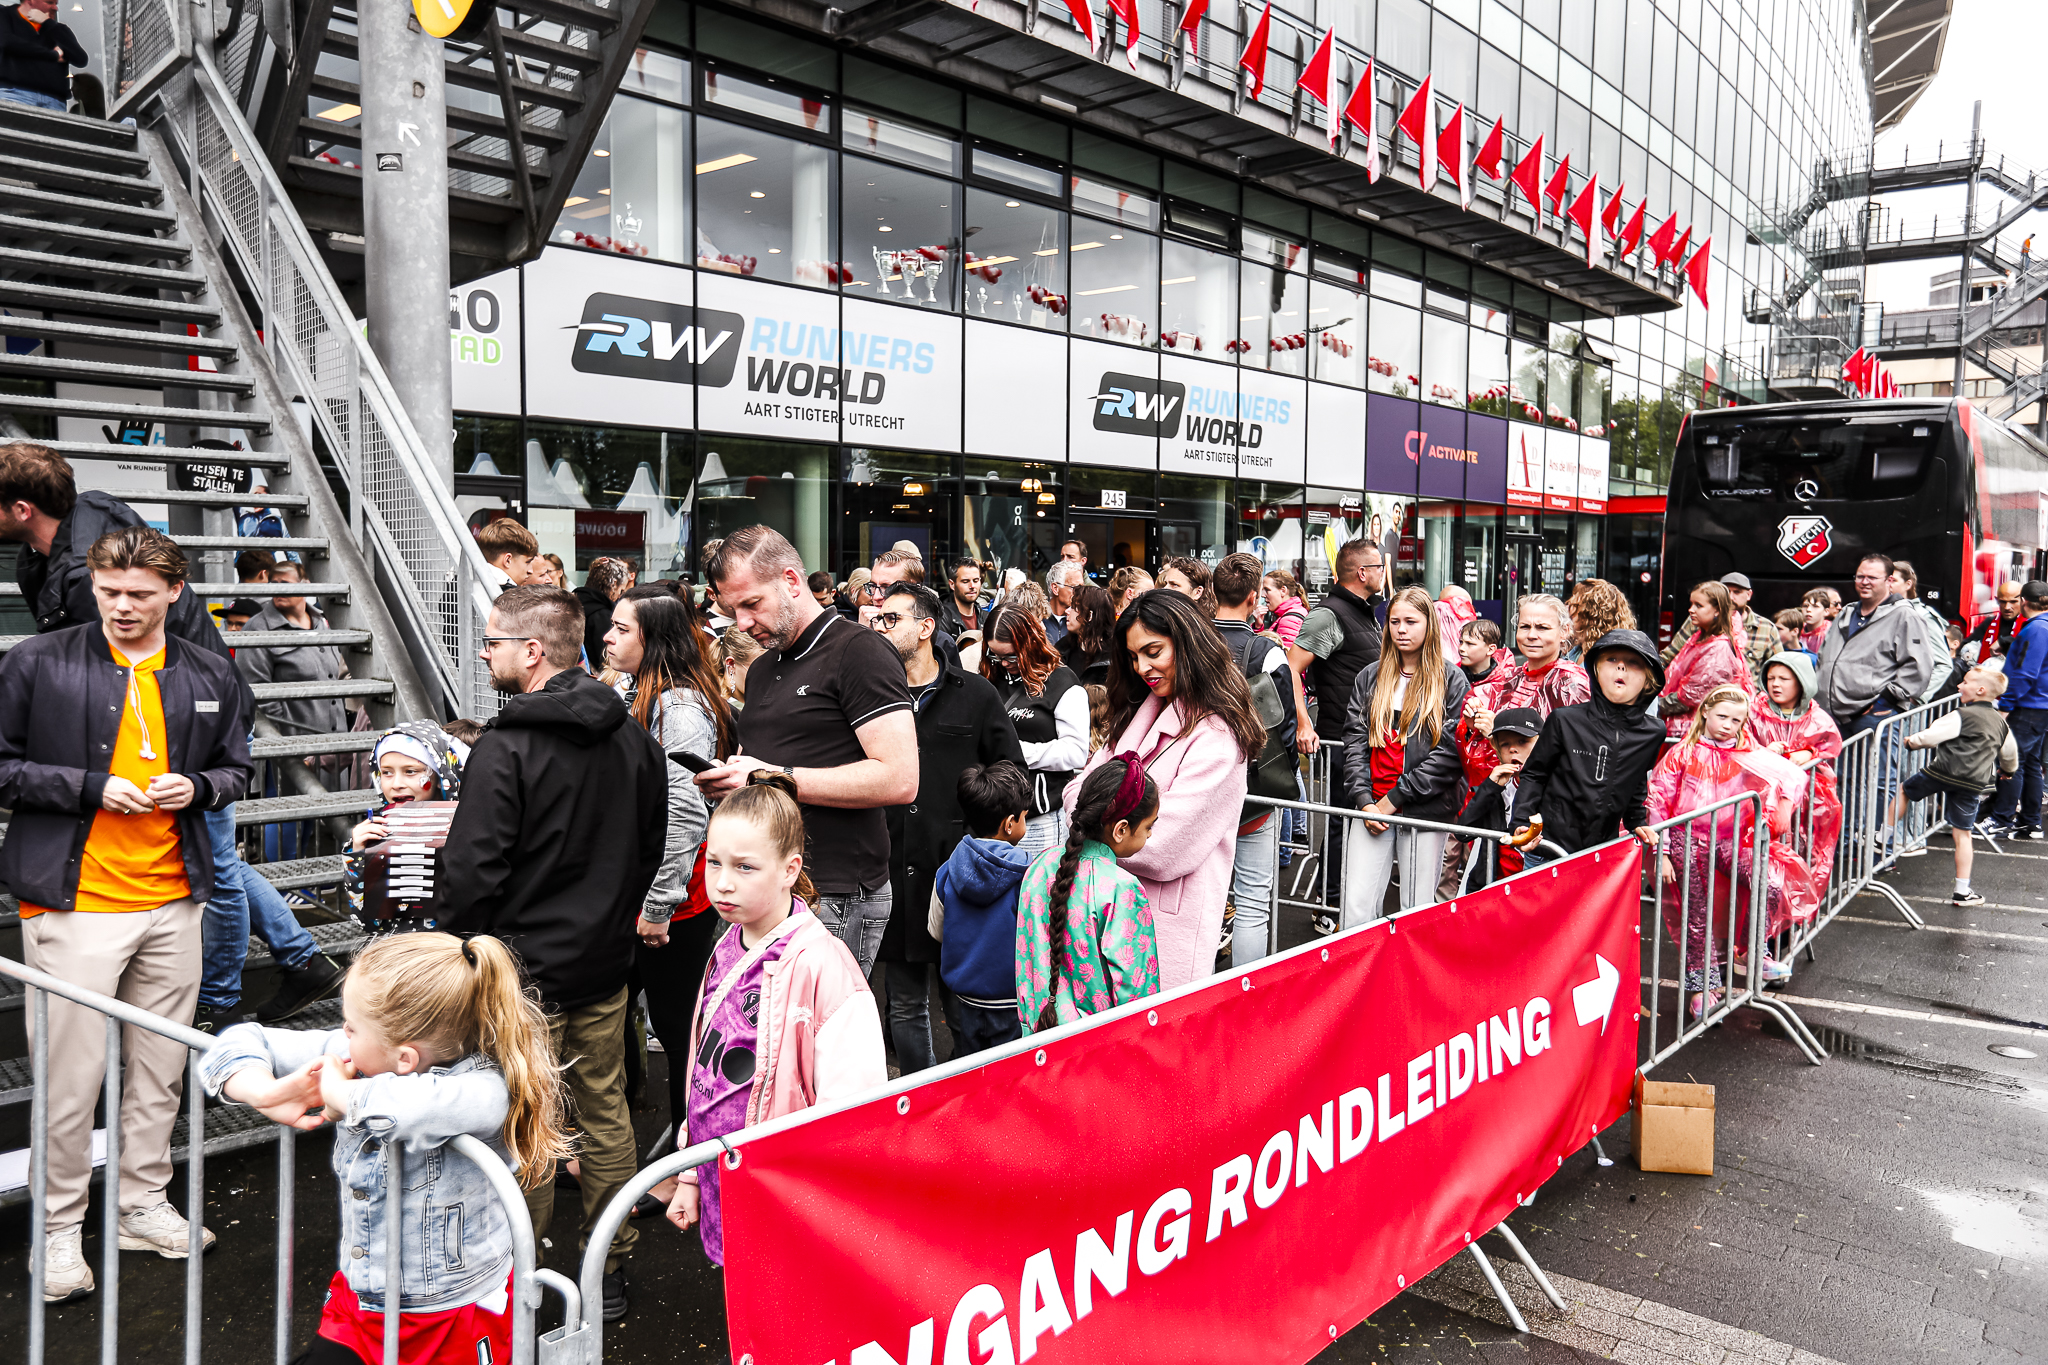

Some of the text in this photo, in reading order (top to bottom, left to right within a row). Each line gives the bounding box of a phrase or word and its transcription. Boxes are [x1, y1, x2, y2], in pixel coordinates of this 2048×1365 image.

[586, 313, 733, 365] RW
[750, 317, 936, 375] RUNNERS
[747, 356, 886, 405] WORLD
[1100, 386, 1179, 422] RW
[1188, 385, 1291, 425] RUNNERS
[744, 401, 780, 417] AART
[849, 412, 905, 430] UTRECHT
[1186, 414, 1263, 449] WORLD
[1184, 448, 1205, 461] AART
[1241, 454, 1273, 468] UTRECHT
[1428, 444, 1479, 464] ACTIVATE
[117, 463, 132, 471] VAN
[232, 468, 244, 481] TE
[193, 475, 236, 493] STALLEN
[1710, 488, 1772, 496] TOURISMO
[1103, 491, 1124, 507] 245
[1791, 522, 1800, 534] F
[1784, 520, 1826, 557] UTRECHT
[1190, 548, 1216, 559] UOCK
[1806, 542, 1820, 556] C
[1927, 591, 1939, 599] 58
[749, 994, 757, 1004] F
[823, 995, 1552, 1365] GANG RONDLEIDING
